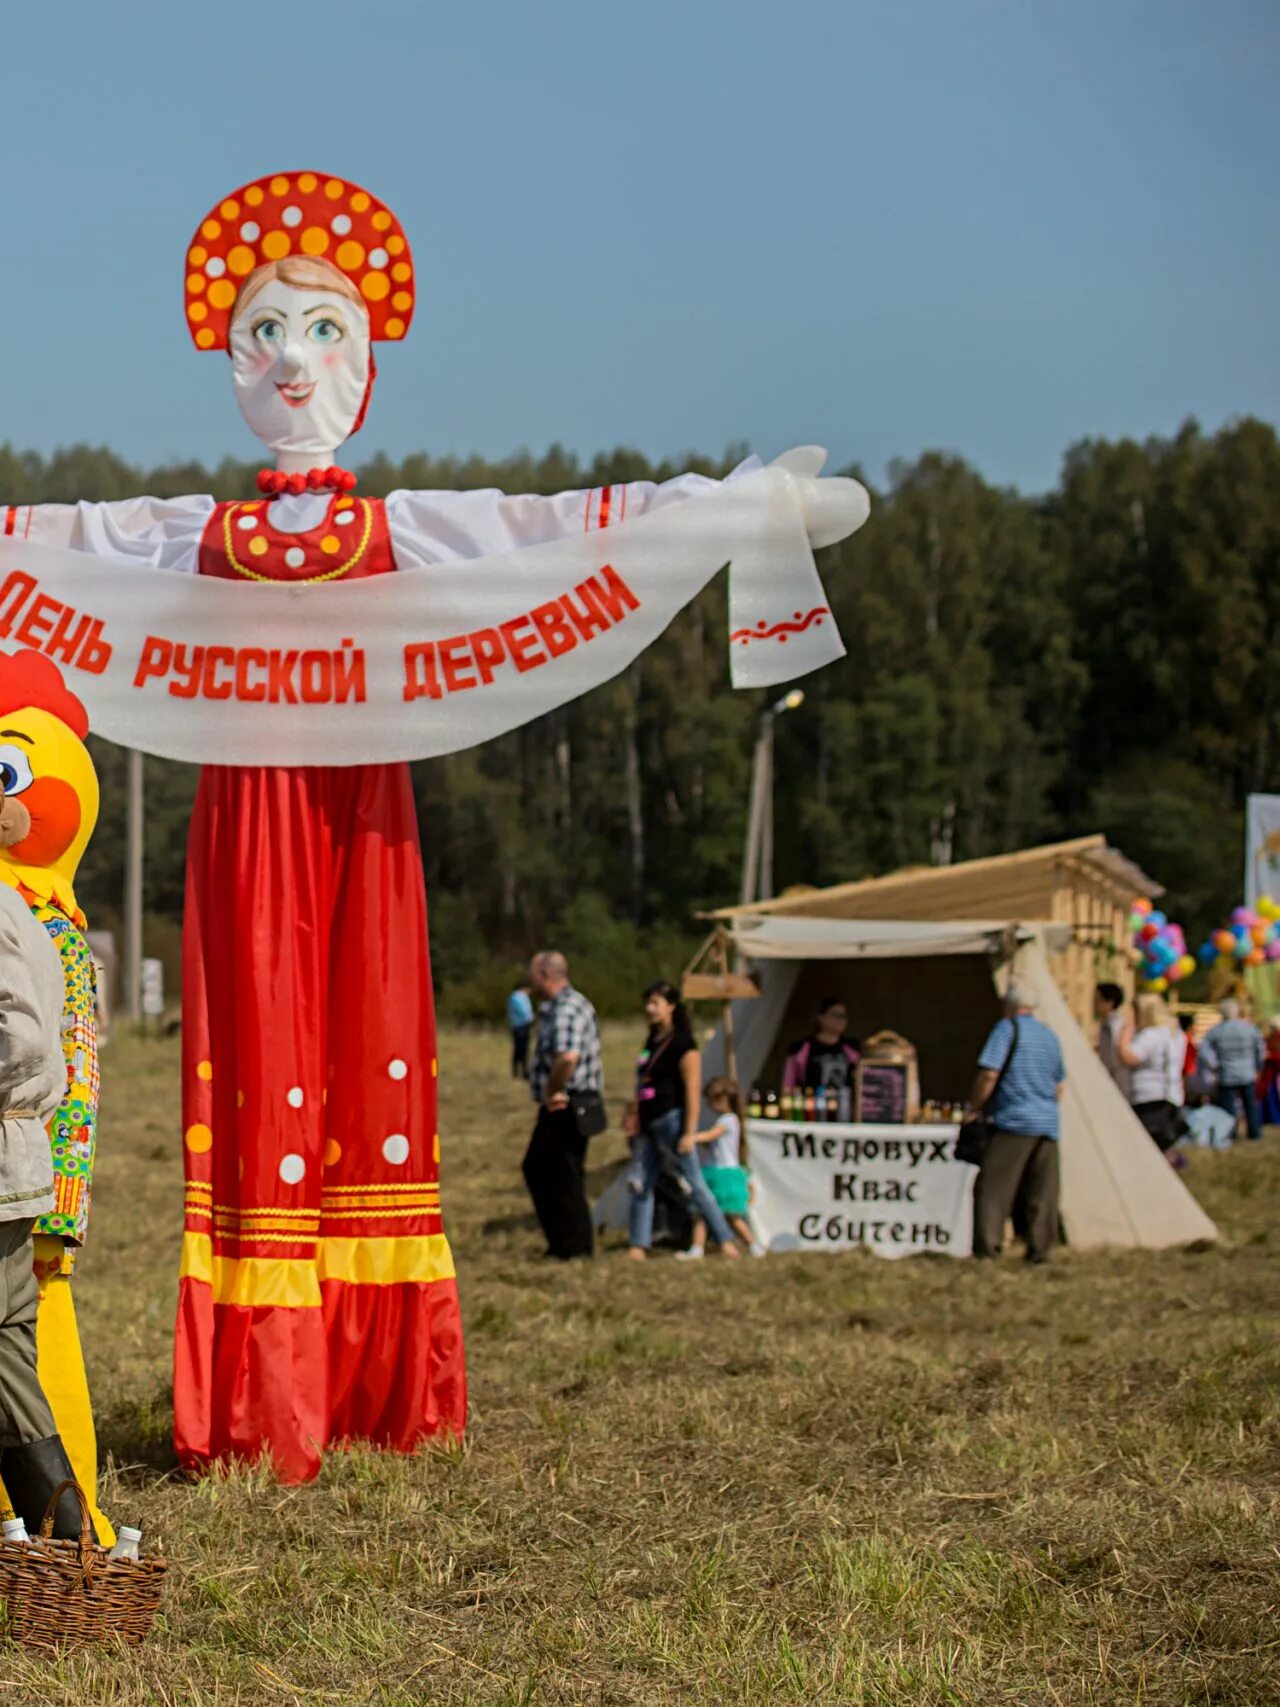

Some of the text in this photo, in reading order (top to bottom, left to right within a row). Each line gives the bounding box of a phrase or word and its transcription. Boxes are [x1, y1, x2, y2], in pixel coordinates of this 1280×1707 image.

[132, 636, 368, 706] РУССКОЙ
[402, 563, 641, 703] ДЕРЕВНИ
[781, 1132, 951, 1168] Медовух
[833, 1173, 920, 1202] Квас
[799, 1213, 951, 1245] Сбитень
